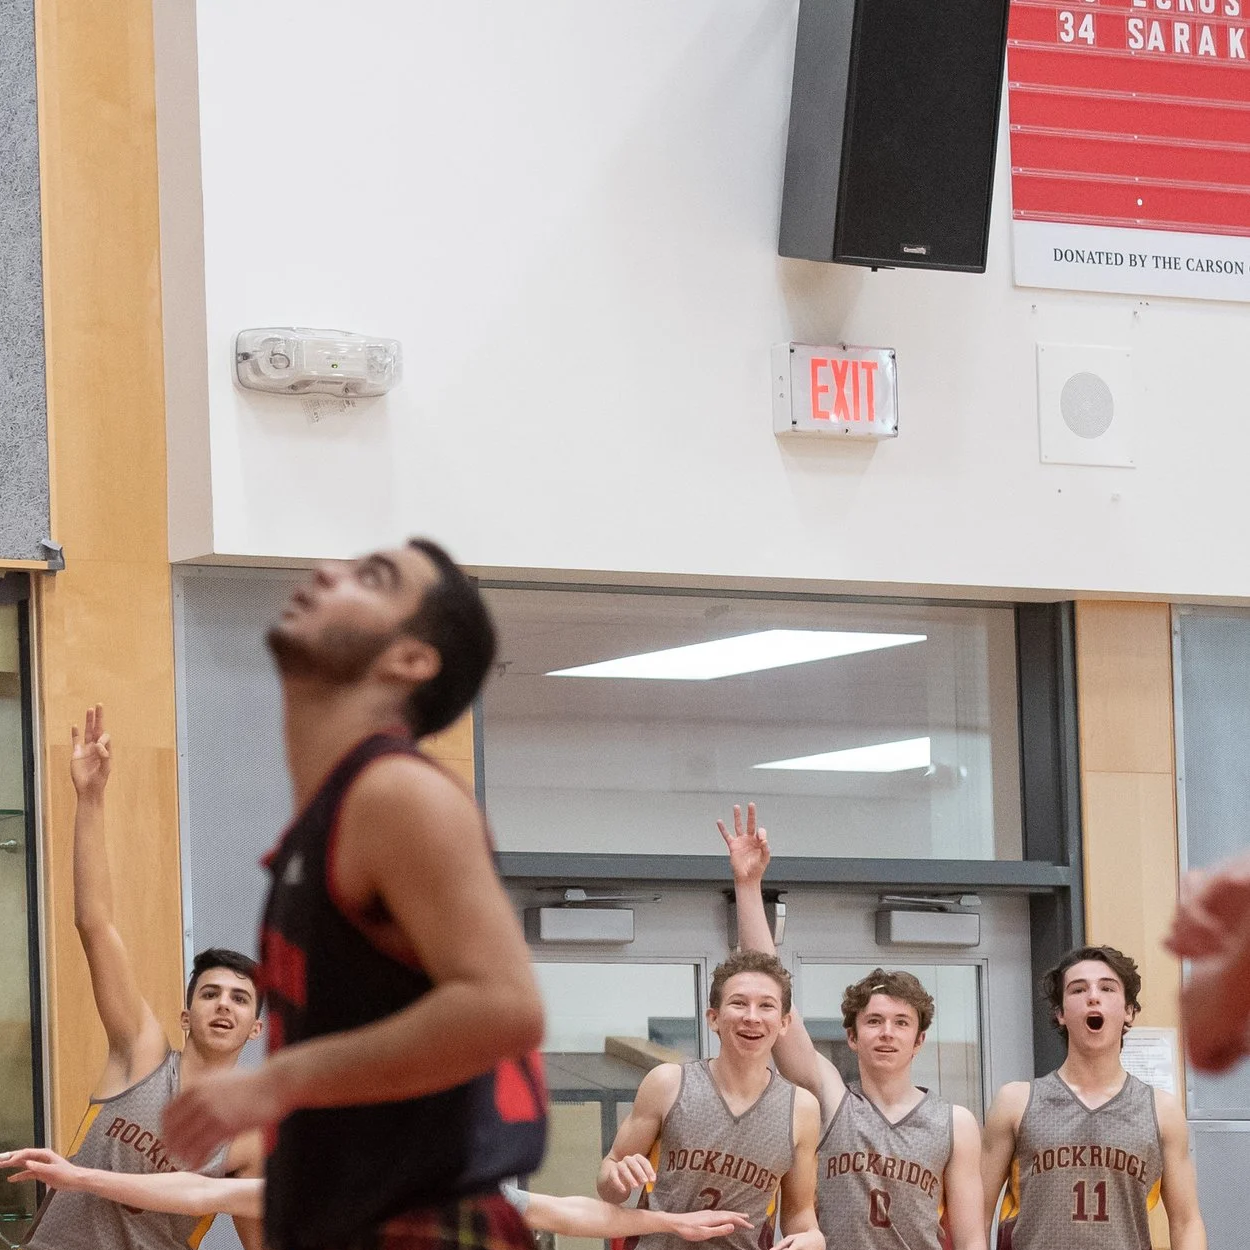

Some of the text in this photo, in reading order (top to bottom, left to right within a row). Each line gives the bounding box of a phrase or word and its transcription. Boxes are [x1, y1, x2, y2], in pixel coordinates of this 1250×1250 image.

[1059, 11, 1246, 59] 34 SARAK
[1053, 248, 1245, 275] DONATED BY THE CARSON
[811, 358, 878, 422] EXIT
[667, 1149, 778, 1192] ROCKRIDGE
[826, 1151, 939, 1199] ROCKRIDGE
[1030, 1145, 1148, 1184] ROCKRIDGE
[869, 1187, 891, 1229] 0
[1072, 1180, 1110, 1221] 11
